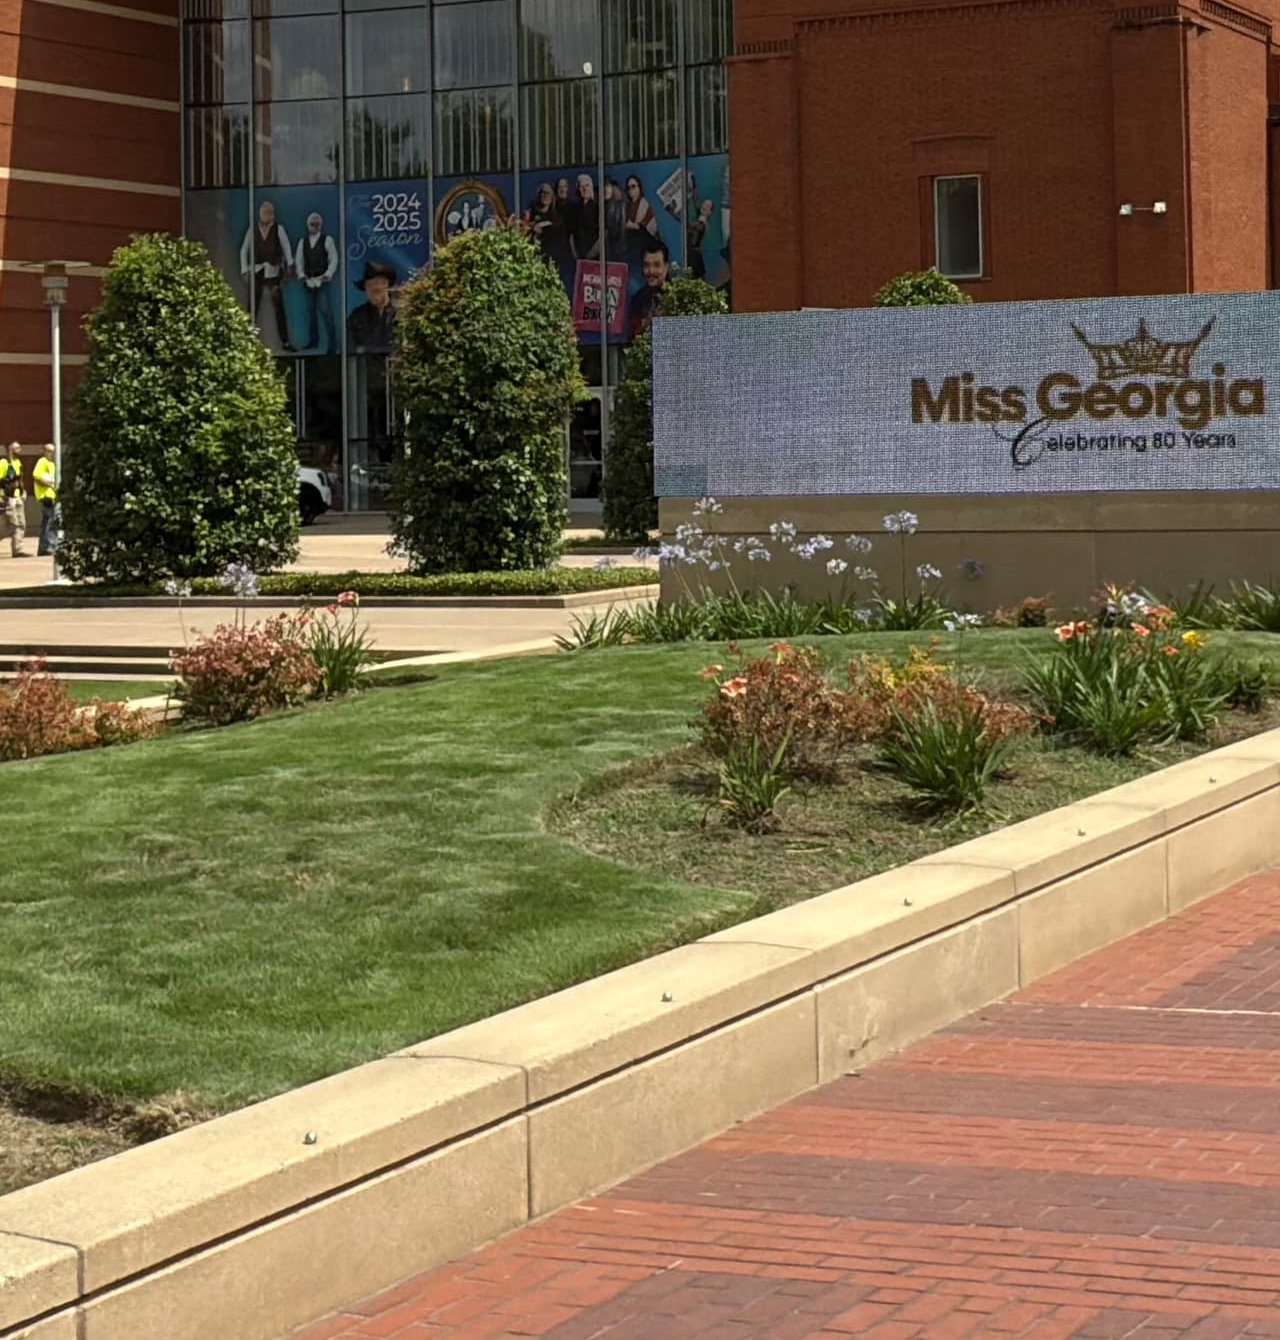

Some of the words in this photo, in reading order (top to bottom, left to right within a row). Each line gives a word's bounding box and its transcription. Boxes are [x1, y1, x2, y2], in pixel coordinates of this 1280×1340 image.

[372, 192, 422, 212] 2024
[373, 211, 421, 232] 2025
[347, 225, 423, 260] Season
[911, 371, 1026, 423] Miss
[1036, 362, 1266, 430] Georgia
[1010, 417, 1147, 469] Celebrating
[1152, 432, 1176, 449] 80
[1182, 432, 1237, 449] Years
